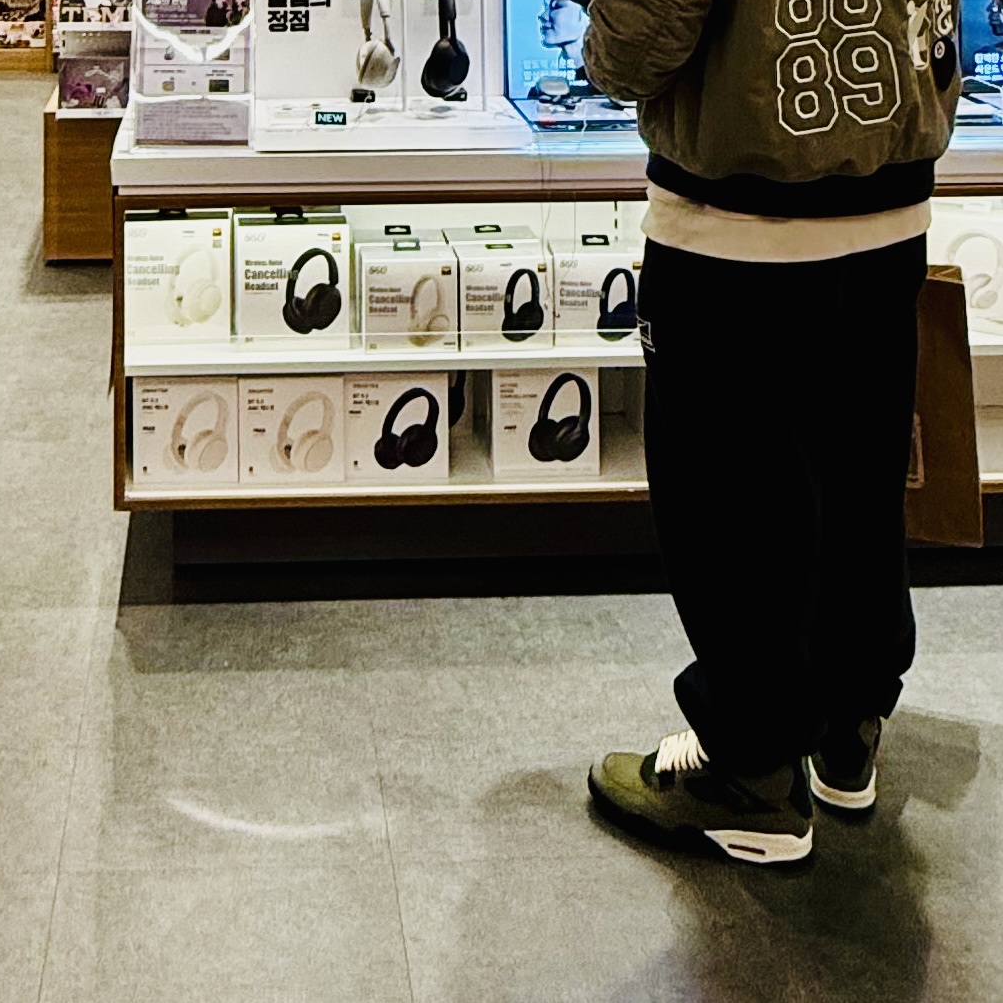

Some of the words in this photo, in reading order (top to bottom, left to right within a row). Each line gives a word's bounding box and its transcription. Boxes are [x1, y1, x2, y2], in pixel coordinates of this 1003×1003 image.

[267, 11, 311, 33] 정점
[777, 31, 902, 136] 89
[317, 113, 343, 124] NEW
[127, 263, 180, 276] Cancelling
[244, 268, 299, 280] Cancelling
[127, 277, 160, 286] Headset
[244, 282, 279, 291] Headset
[559, 299, 589, 307] Headset
